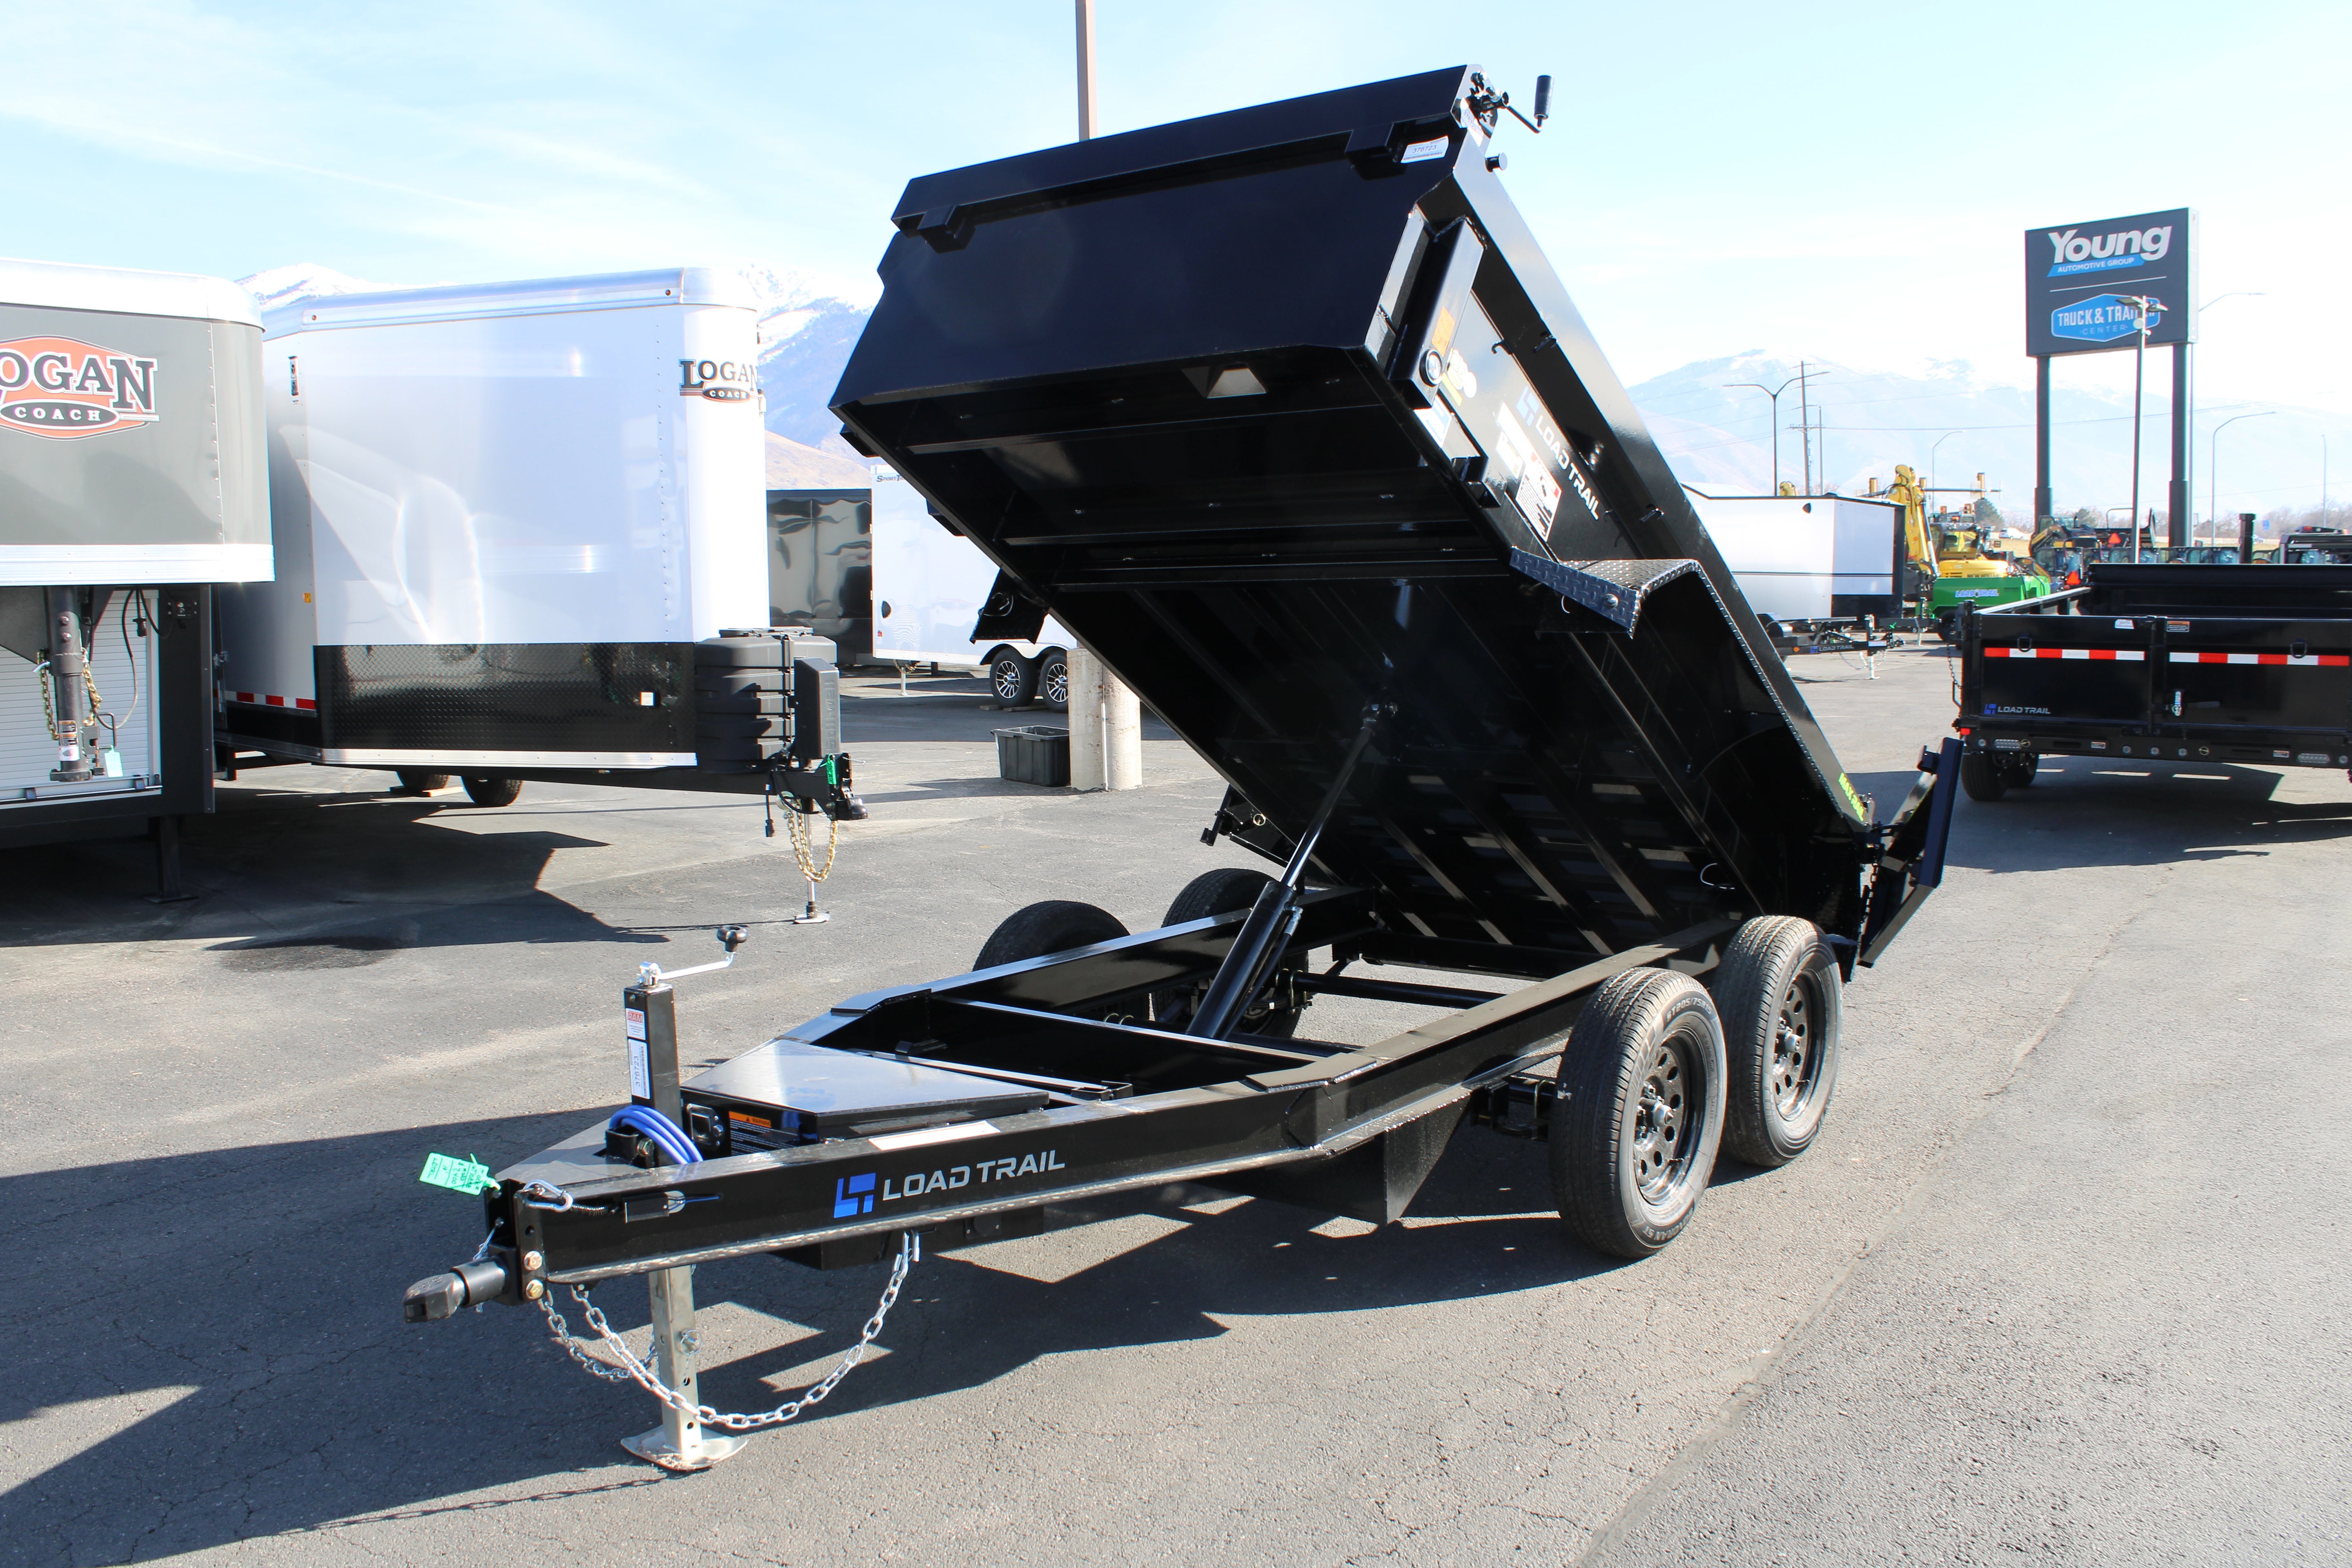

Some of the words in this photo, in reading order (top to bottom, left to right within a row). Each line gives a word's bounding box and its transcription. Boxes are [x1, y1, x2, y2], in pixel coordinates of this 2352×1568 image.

[1412, 144, 1437, 154] 376723
[2048, 225, 2172, 264] Young
[2058, 261, 2106, 273] AUTOMOTIVE
[2107, 257, 2135, 267] GROUP
[2058, 308, 2094, 327] TRUCK
[2094, 307, 2105, 324] &
[2082, 324, 2126, 335] CENTER
[0, 348, 158, 414] OGAN
[709, 390, 747, 399] COACH
[14, 406, 101, 422] COACH
[1535, 414, 1571, 470] LOAD
[1568, 462, 1600, 521] TRAIL
[1978, 589, 1999, 597] TRAIL
[1838, 772, 1854, 801] MAX
[1850, 793, 1865, 822] RAIL
[628, 1012, 644, 1023] RAM
[882, 1165, 971, 1201] LOAD
[976, 1149, 1066, 1183] TRAIL
